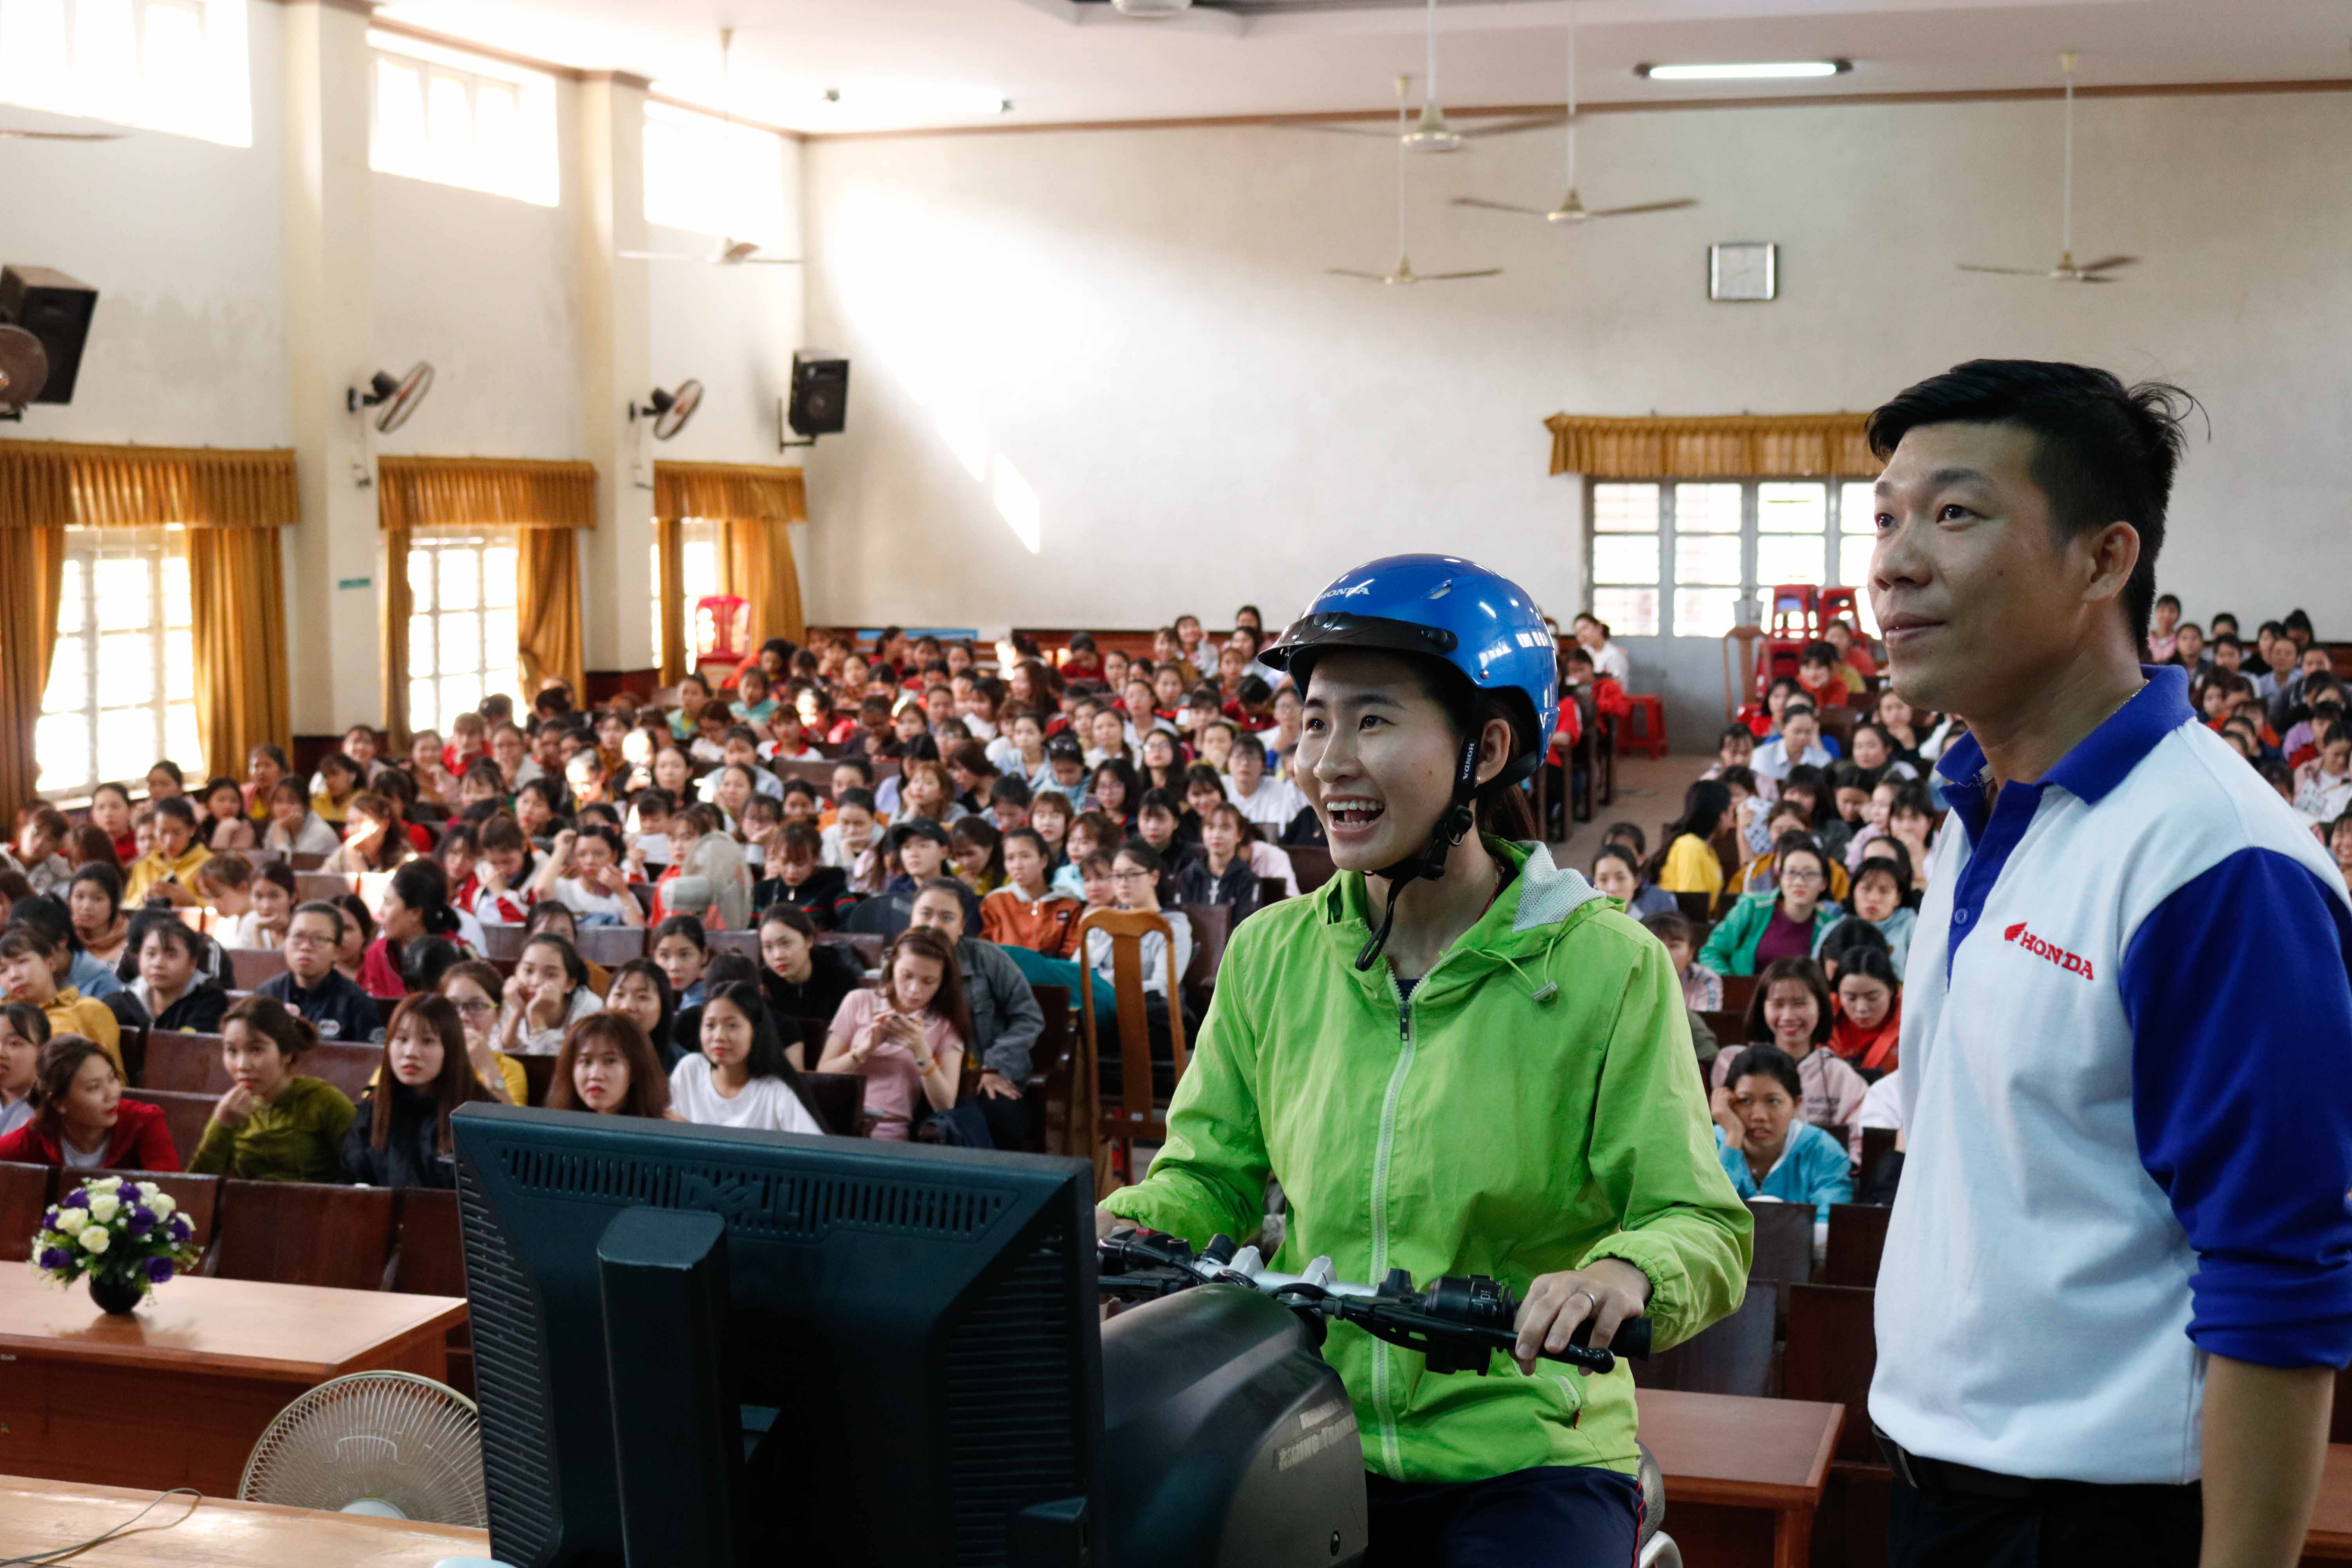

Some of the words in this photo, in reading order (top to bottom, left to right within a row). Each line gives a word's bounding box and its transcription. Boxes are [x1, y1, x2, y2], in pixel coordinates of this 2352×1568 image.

[1317, 587, 1370, 602] HONDA
[1463, 743, 1475, 780] HONDA
[2020, 931, 2094, 980] HONDA
[679, 1174, 800, 1225] DELL
